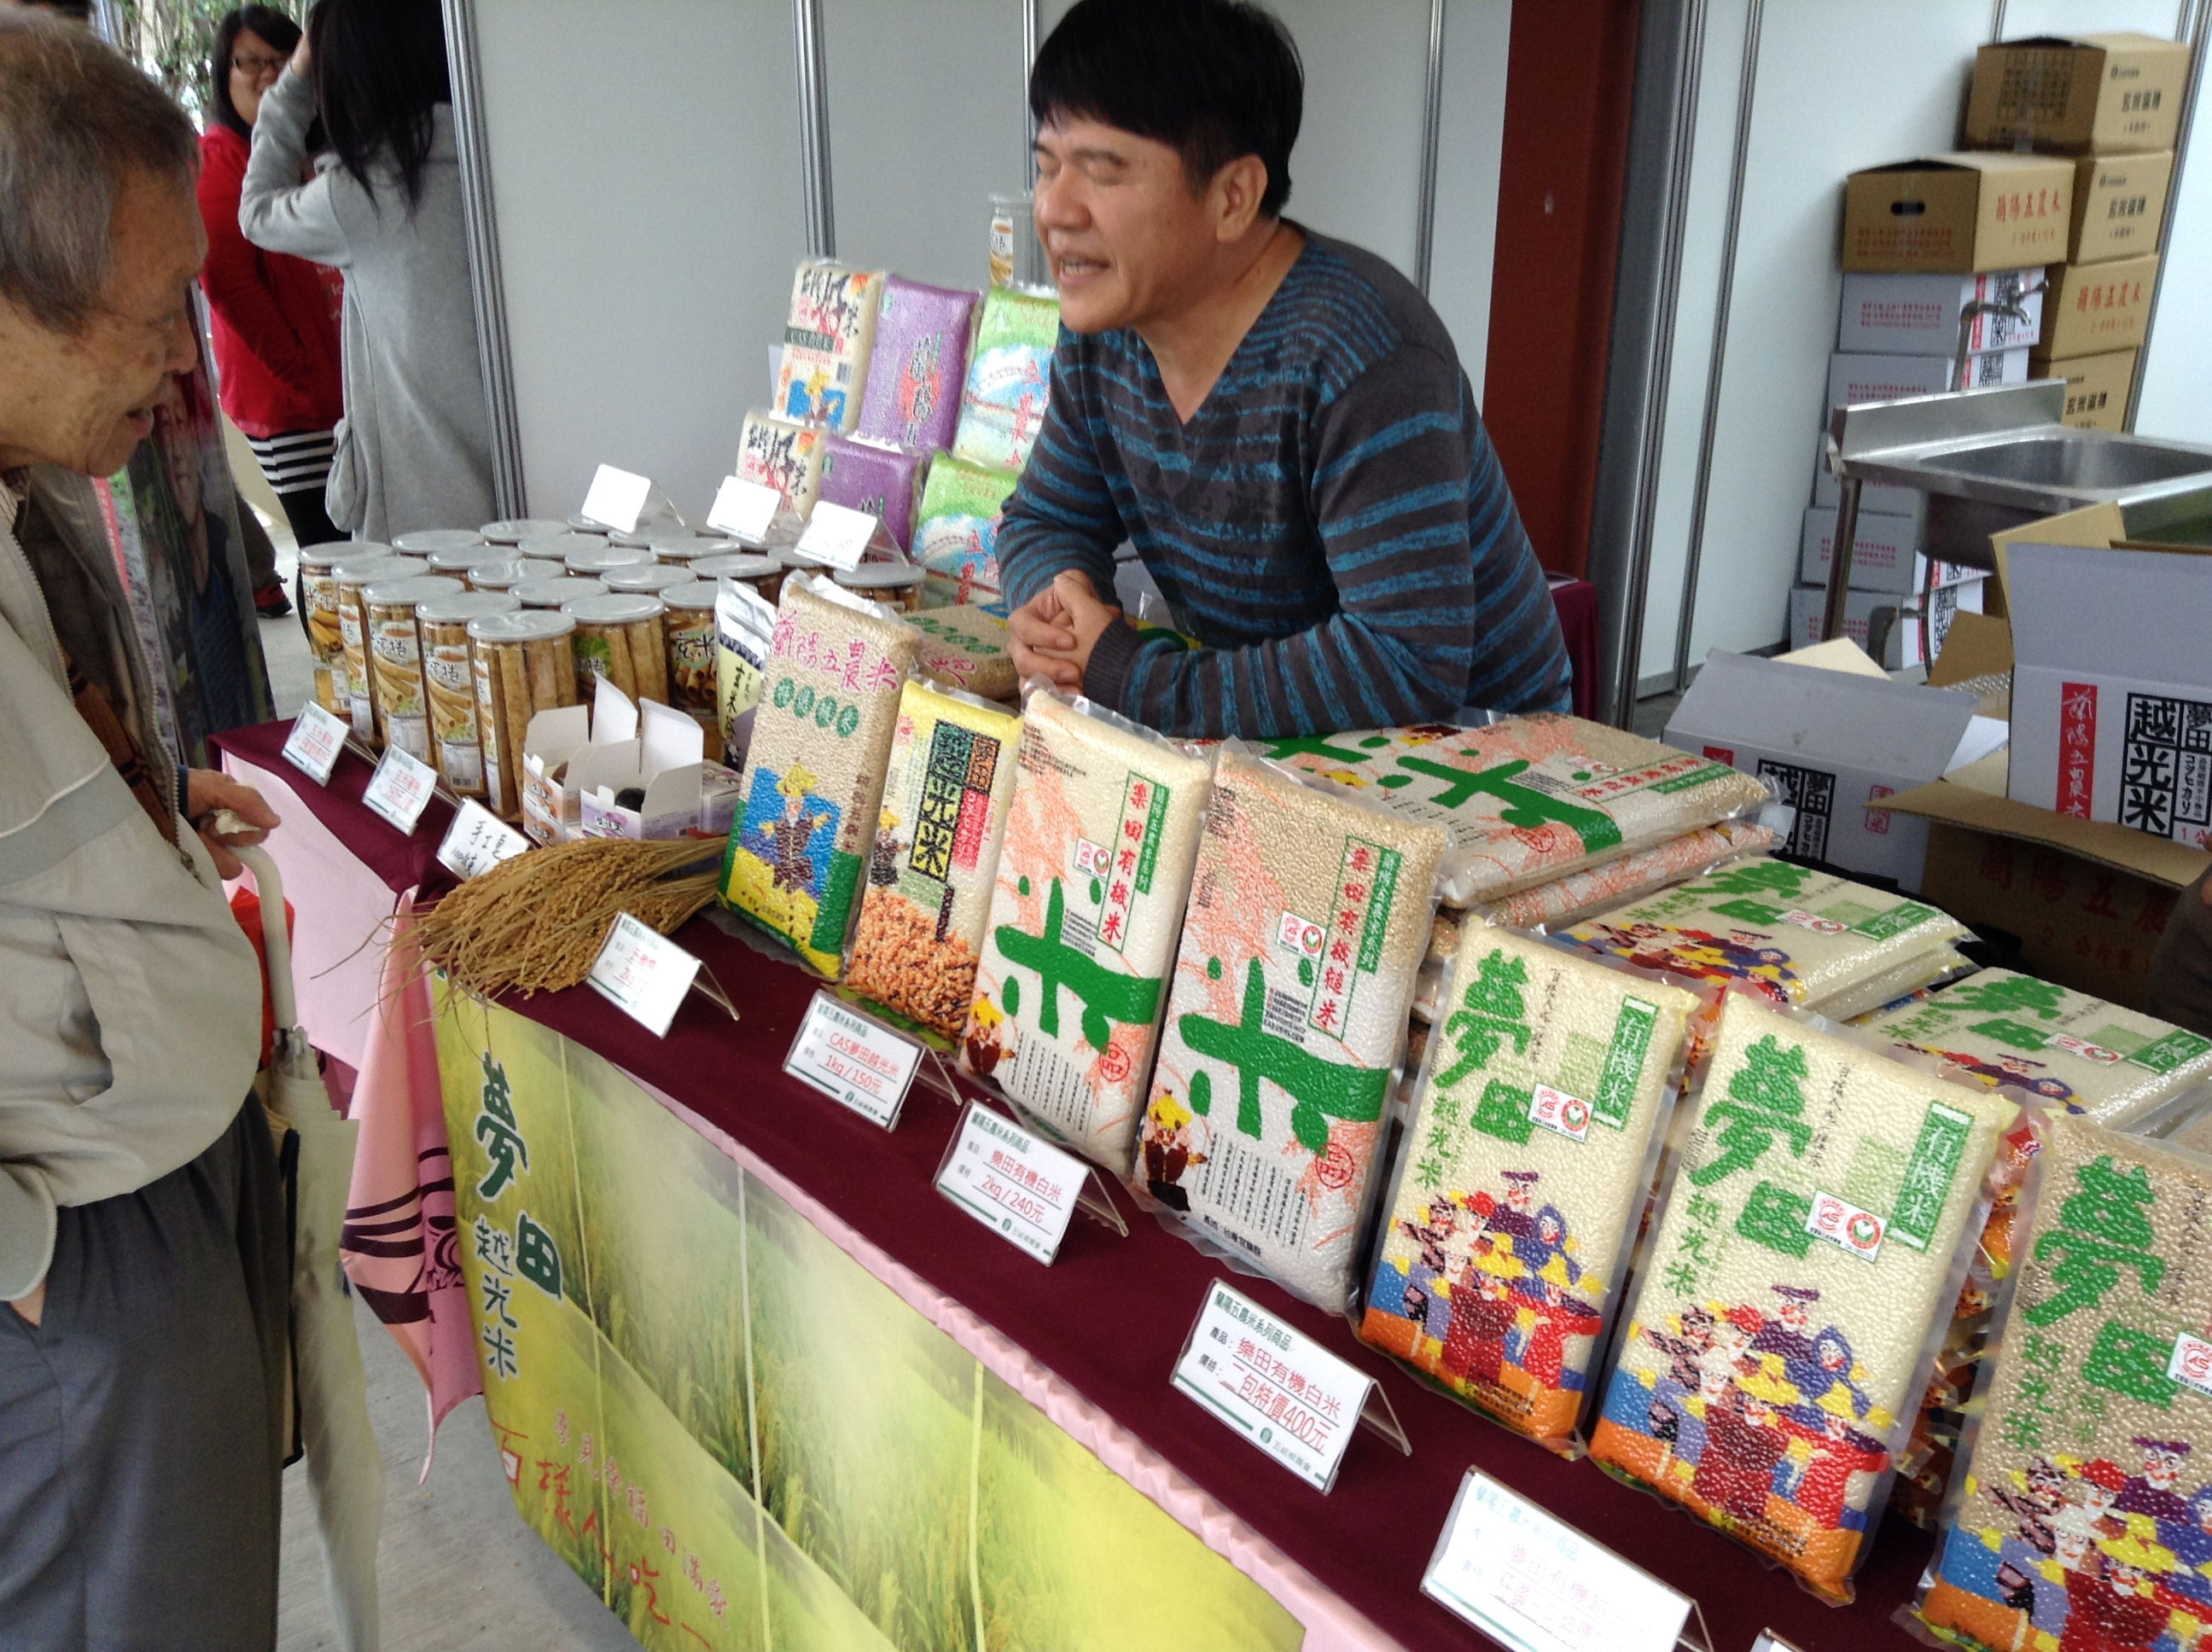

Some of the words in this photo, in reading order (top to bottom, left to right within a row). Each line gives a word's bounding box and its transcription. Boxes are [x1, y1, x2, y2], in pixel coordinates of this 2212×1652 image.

[910, 723, 975, 881] 越光米
[2123, 698, 2179, 833] 越光米
[1600, 1015, 1649, 1108] 有機米
[990, 1149, 1062, 1202] 樂田有機白米
[1895, 1125, 1954, 1227] 有機米
[474, 1220, 518, 1378] 越光米
[1236, 1336, 1342, 1420] 樂田有機白米
